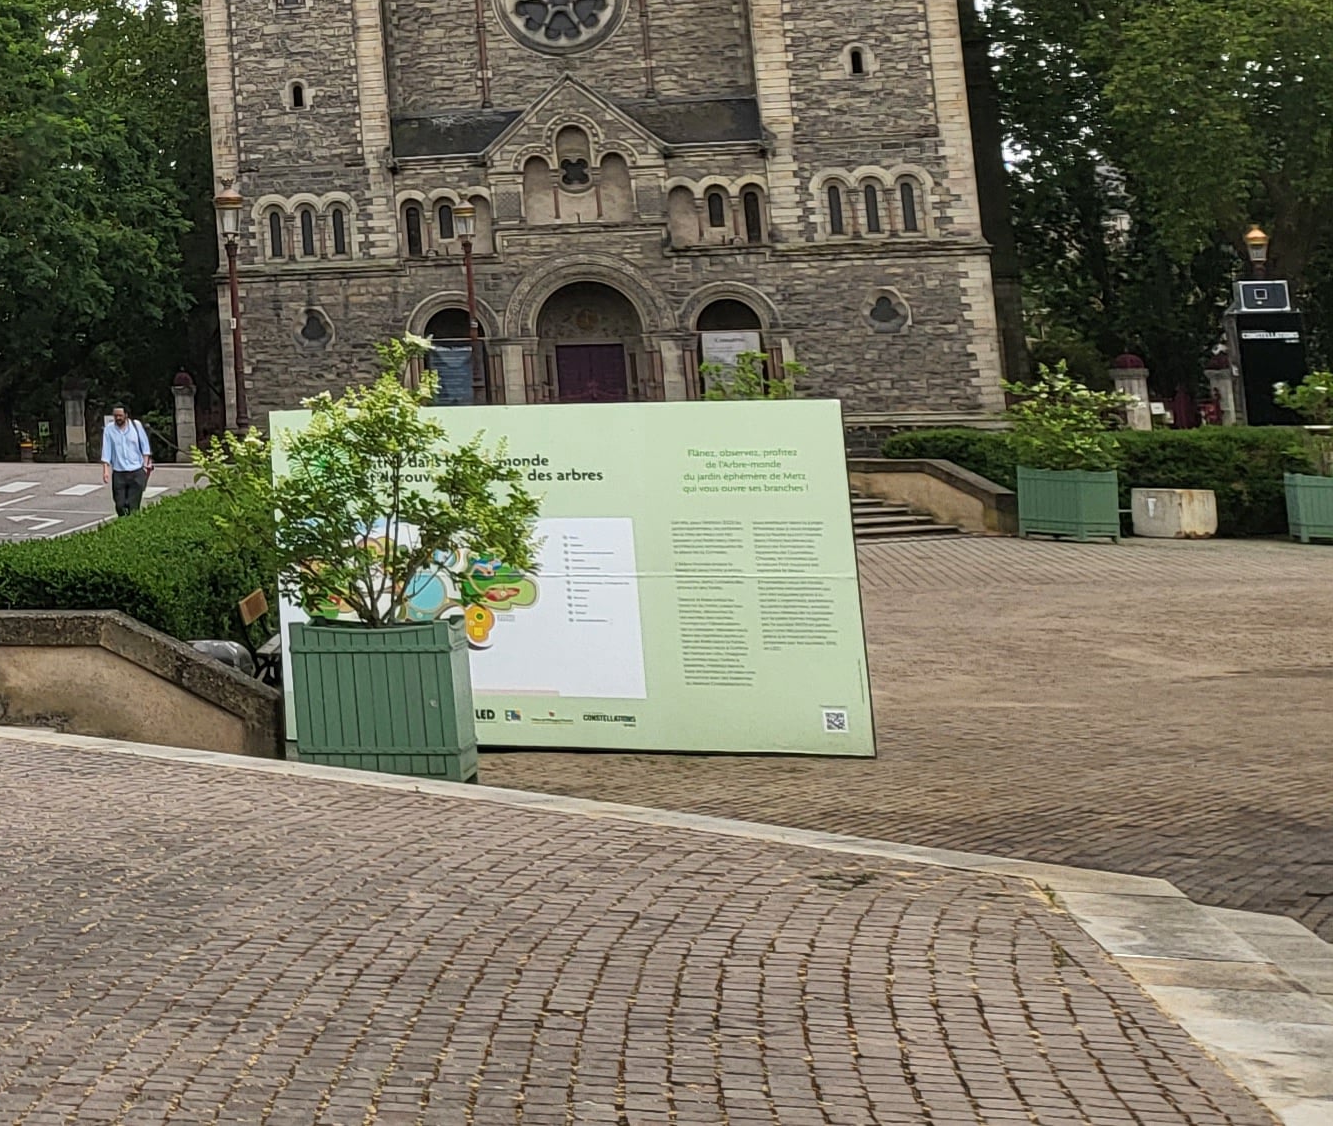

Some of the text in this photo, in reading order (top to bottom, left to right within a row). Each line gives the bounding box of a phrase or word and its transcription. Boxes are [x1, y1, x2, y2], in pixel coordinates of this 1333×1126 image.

[763, 448, 798, 458] profitez
[705, 460, 716, 469] de
[527, 468, 553, 482] des
[556, 468, 604, 482] arbres
[683, 473, 695, 481] du
[697, 472, 721, 482] jardin
[769, 472, 781, 480] de
[783, 472, 806, 480] Metz
[683, 485, 697, 494] qui
[764, 484, 804, 492] branches
